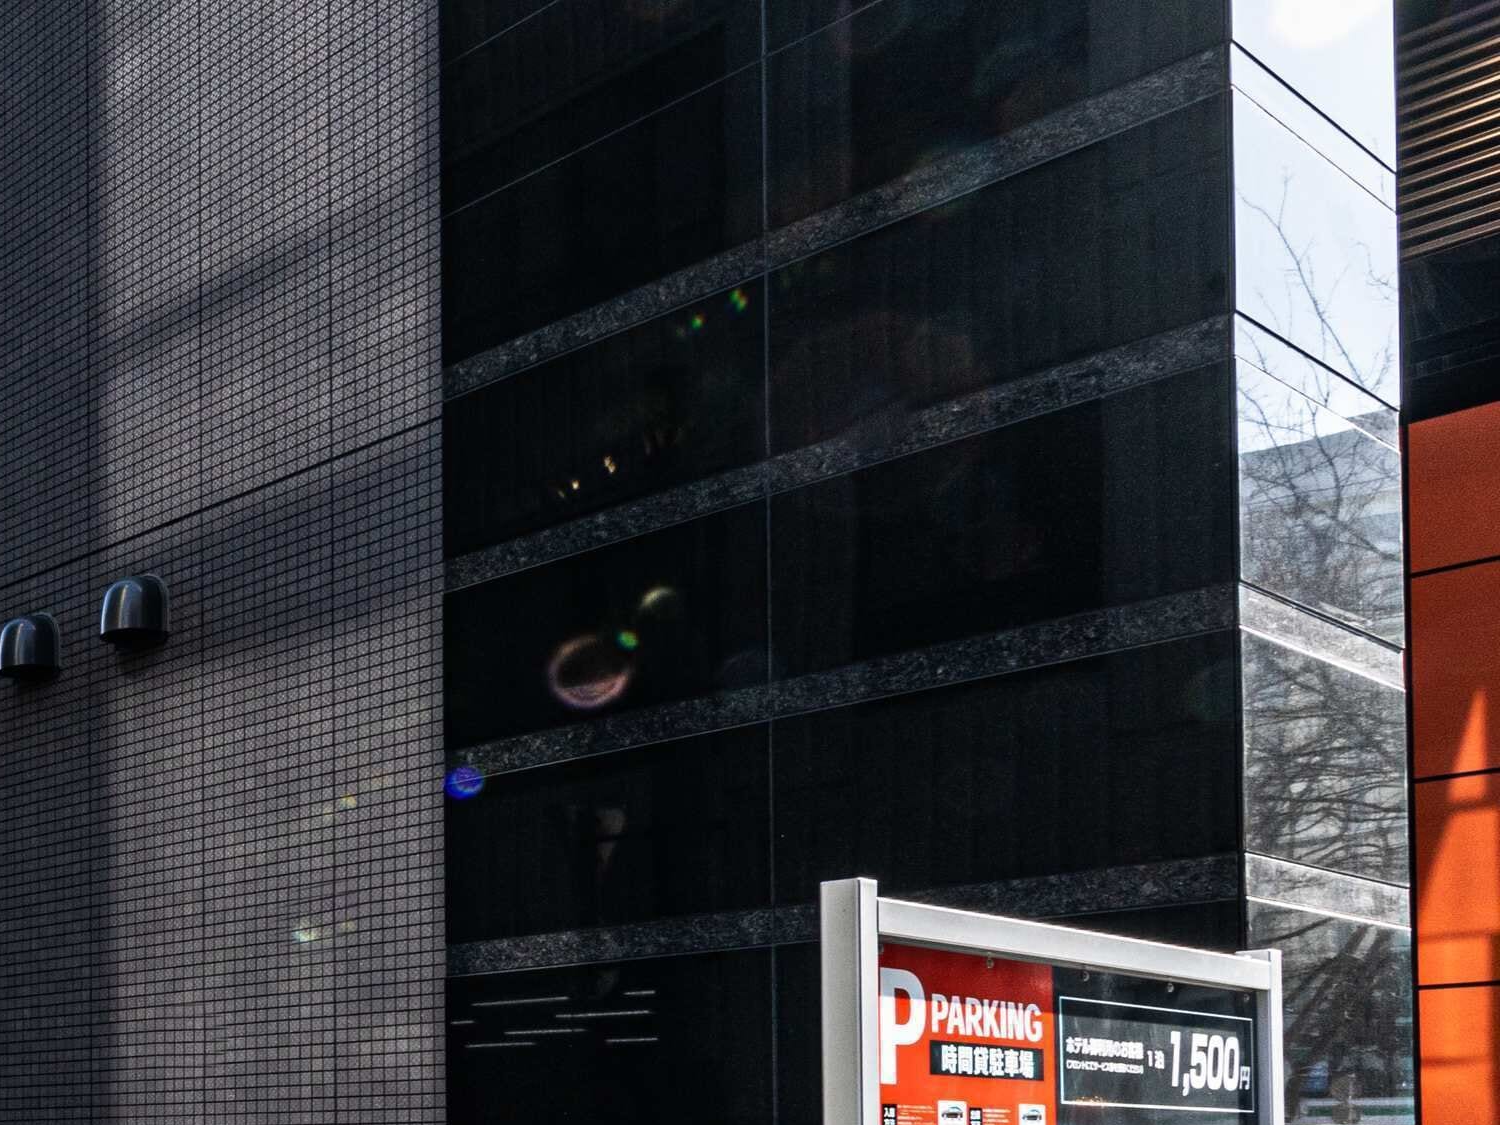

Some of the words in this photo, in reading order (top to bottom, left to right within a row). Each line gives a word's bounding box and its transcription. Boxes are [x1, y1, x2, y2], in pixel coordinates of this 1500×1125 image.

[879, 967, 926, 1085] P
[931, 993, 1043, 1042] PARKING
[941, 1044, 1034, 1079] 時間貸駐車場
